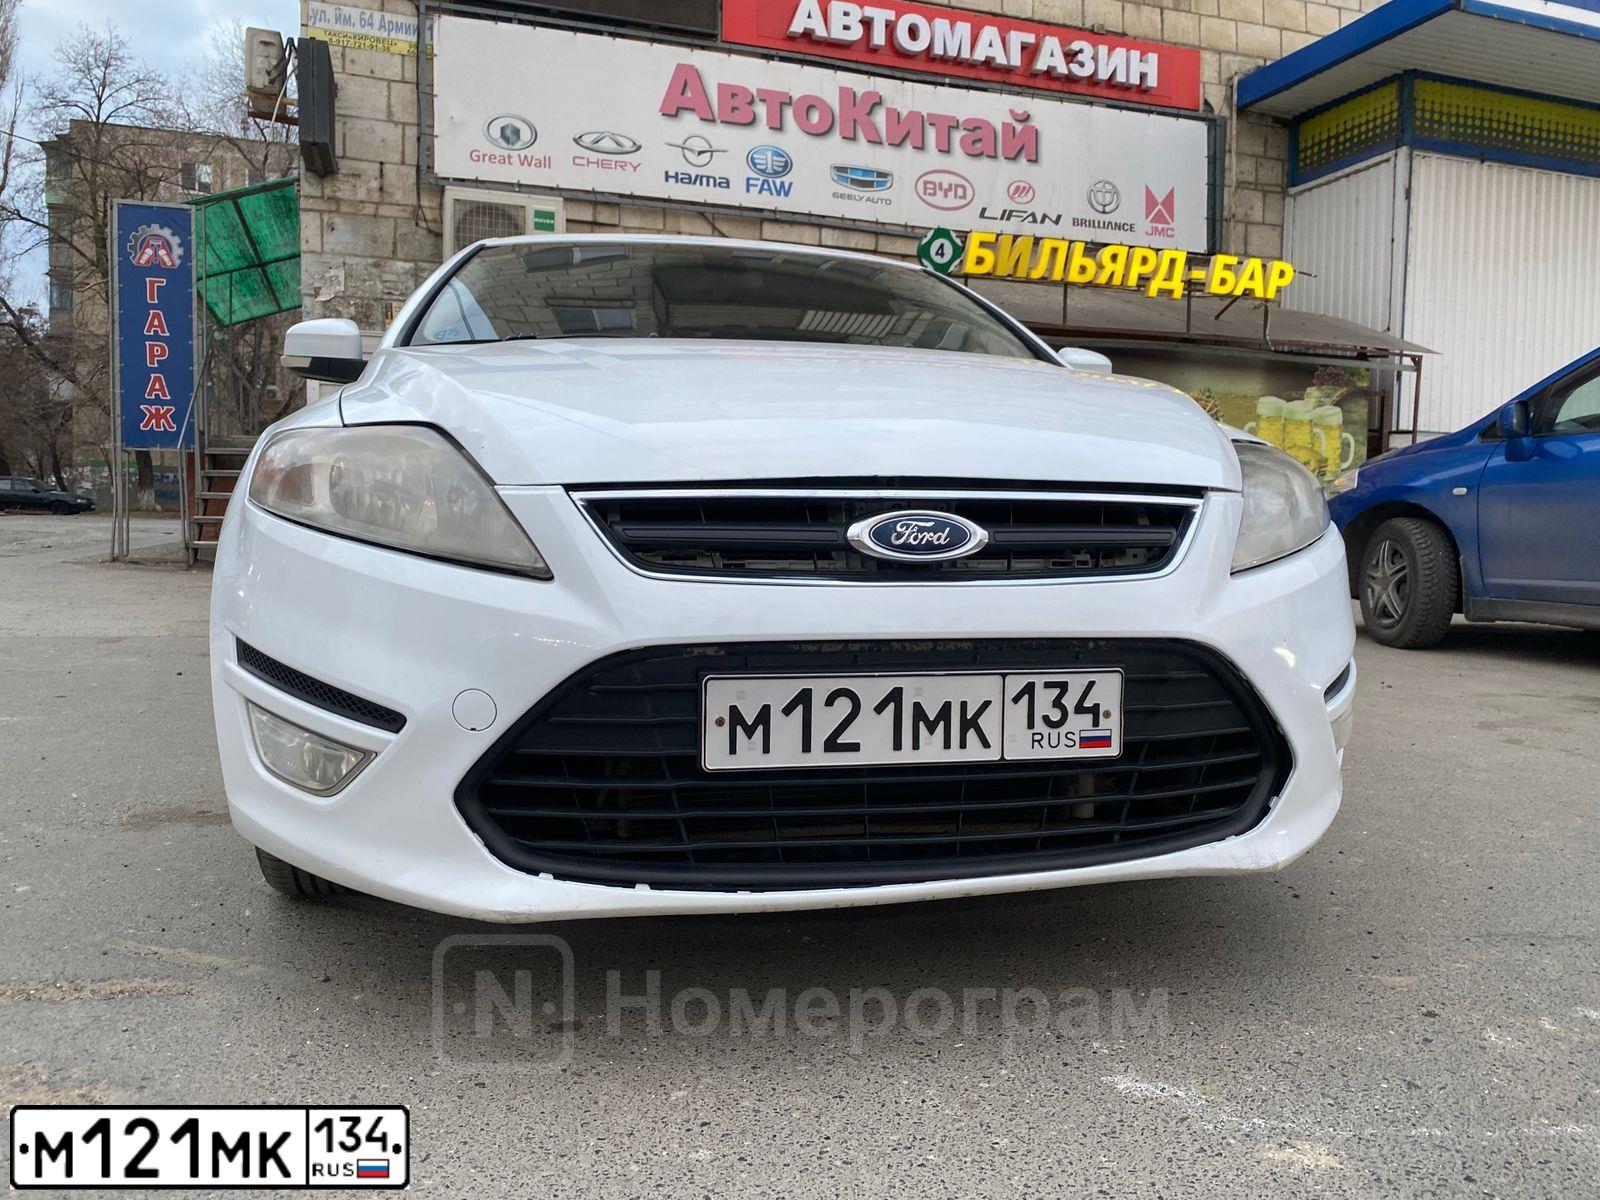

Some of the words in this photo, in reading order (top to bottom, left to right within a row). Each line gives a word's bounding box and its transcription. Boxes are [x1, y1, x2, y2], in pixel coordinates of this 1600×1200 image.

[311, 8, 330, 26] ул.
[360, 11, 374, 29] 64
[787, 0, 1158, 92] АВТОМАГАЗИН
[658, 62, 1039, 163] АвтоКитай
[469, 149, 513, 165] Great
[517, 154, 552, 169] Wall
[572, 155, 643, 173] CHERY
[745, 176, 794, 198] FAW
[923, 180, 967, 200] BYD
[866, 196, 892, 205] AUTO
[978, 207, 1062, 226] LIFAN
[1072, 217, 1136, 233] BRILLIANCE
[1145, 227, 1175, 238] JMC
[935, 242, 945, 259] 4
[963, 231, 1294, 299] БИЛЬЯРД-БАР
[140, 277, 176, 431] ГАРАЖ
[891, 520, 951, 545] Ford
[1011, 680, 1100, 730] 134
[1032, 731, 1077, 749] RUS
